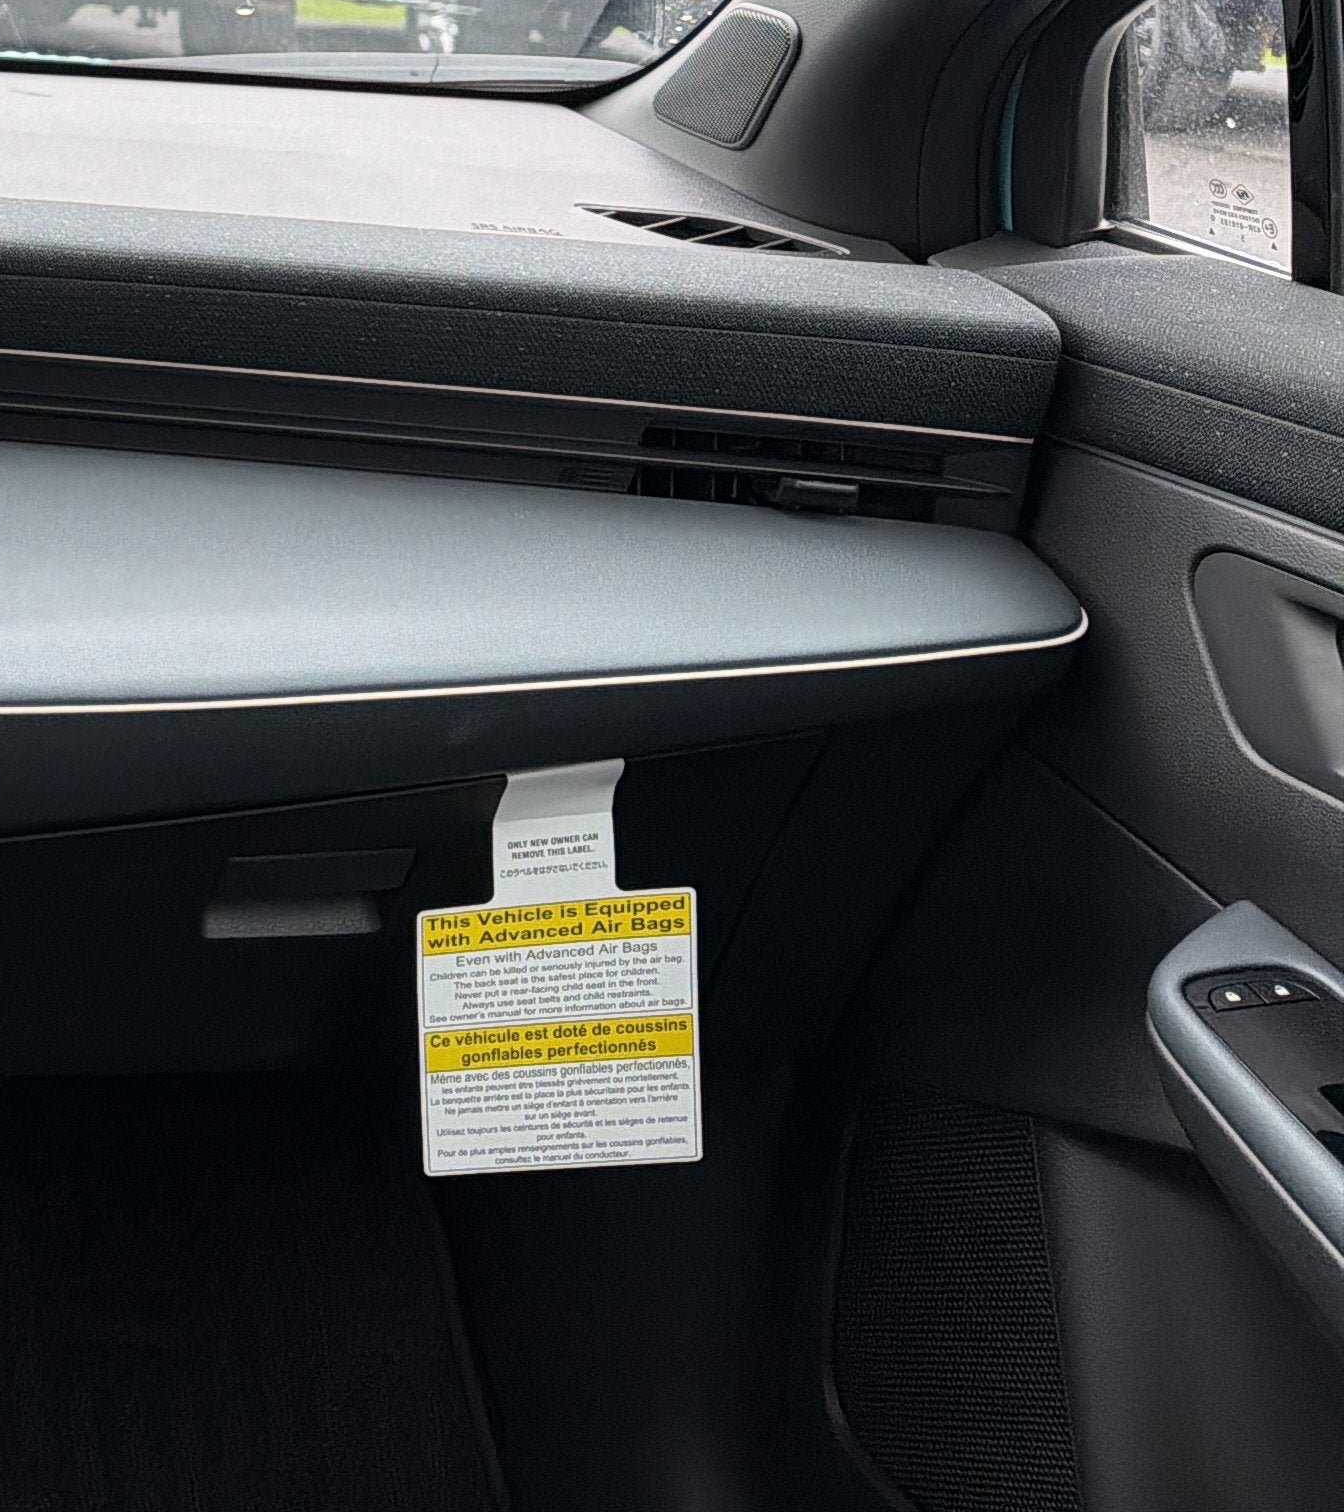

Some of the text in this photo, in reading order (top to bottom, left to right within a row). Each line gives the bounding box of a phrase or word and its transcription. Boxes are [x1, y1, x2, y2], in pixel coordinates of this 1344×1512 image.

[507, 832, 599, 850] ONLY NEW OWNER CAN
[511, 849, 545, 860] REMOVE
[547, 847, 566, 857] THIS
[426, 895, 685, 931] This Vehicle is Equipped
[427, 913, 684, 949] with Advanced Air Bags
[455, 939, 657, 967] Even with Advanced Air Bags
[429, 970, 468, 981] Children
[488, 967, 501, 976] be
[502, 965, 527, 975] killed
[541, 961, 582, 973] seriously
[584, 958, 616, 970] injured
[618, 957, 630, 967] by
[632, 956, 647, 965] the
[649, 955, 662, 963] air
[453, 980, 472, 989] The
[474, 978, 496, 988] back
[498, 977, 518, 986] seat
[520, 976, 528, 984] is
[530, 974, 545, 983] the
[548, 972, 576, 981] safest
[578, 970, 603, 980] place
[605, 968, 618, 977] for
[454, 990, 482, 1000] Never
[484, 989, 499, 998] put
[509, 984, 559, 996] rear-facing
[561, 982, 583, 991] child
[585, 981, 605, 989] seat
[607, 979, 616, 987] in
[618, 978, 634, 987] the
[461, 999, 495, 1011] Always
[496, 999, 514, 1007] use
[516, 996, 536, 1005] seat
[538, 994, 560, 1004] belts
[562, 993, 580, 1002] and
[582, 991, 604, 1000] child
[429, 1013, 447, 1023] See
[449, 1011, 485, 1021] owner's
[487, 1008, 521, 1018] manual
[523, 1007, 536, 1015] for
[538, 1006, 562, 1014] more
[564, 1001, 616, 1012] information
[618, 999, 645, 1009] about
[429, 1014, 687, 1048] Ce véhicule est doté de coussins
[461, 1037, 656, 1066] gonflables perfectionnés
[430, 1072, 461, 1084] Même
[464, 1072, 489, 1082] avec
[491, 1069, 510, 1080] des
[512, 1066, 557, 1079] coussins
[559, 1061, 613, 1077] gonflables
